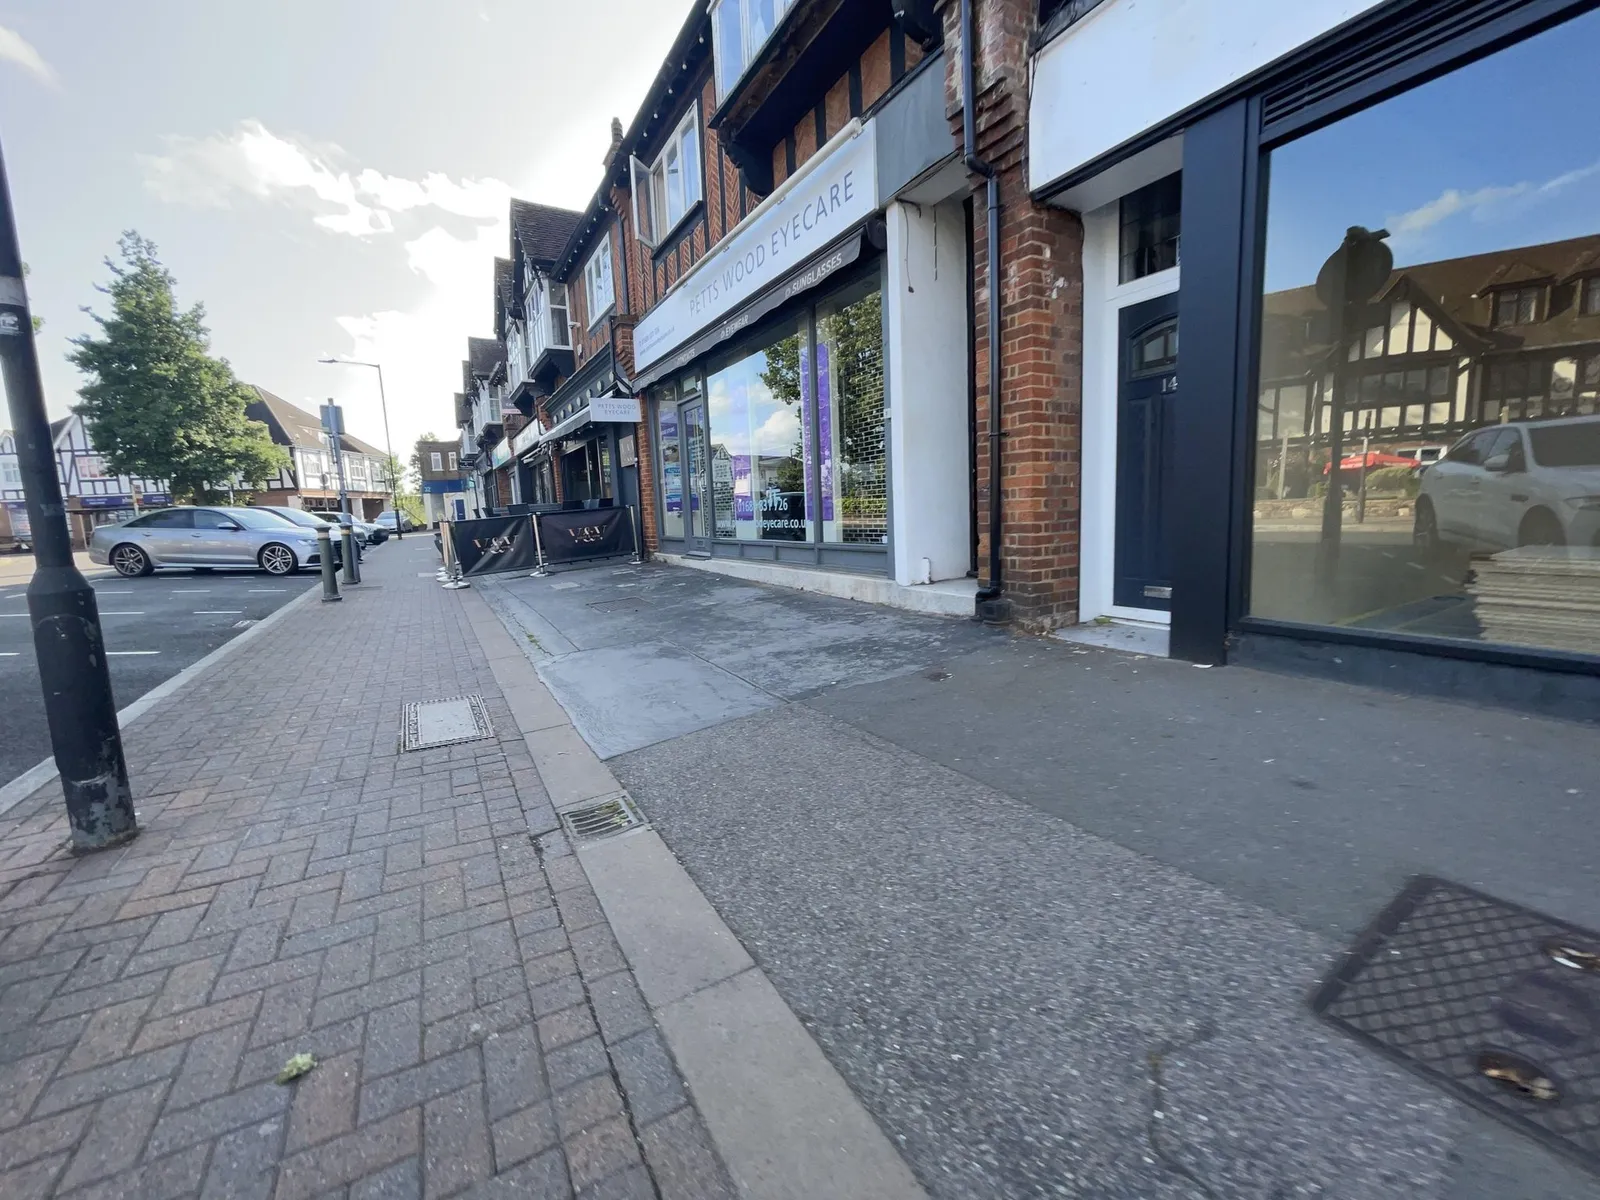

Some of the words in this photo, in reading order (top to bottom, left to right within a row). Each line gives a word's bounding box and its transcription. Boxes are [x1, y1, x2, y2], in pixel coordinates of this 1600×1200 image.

[689, 279, 719, 317] PETTS
[722, 244, 766, 292] WOOD
[771, 170, 854, 257] EYECARE
[791, 253, 842, 294] SUNGLASSES
